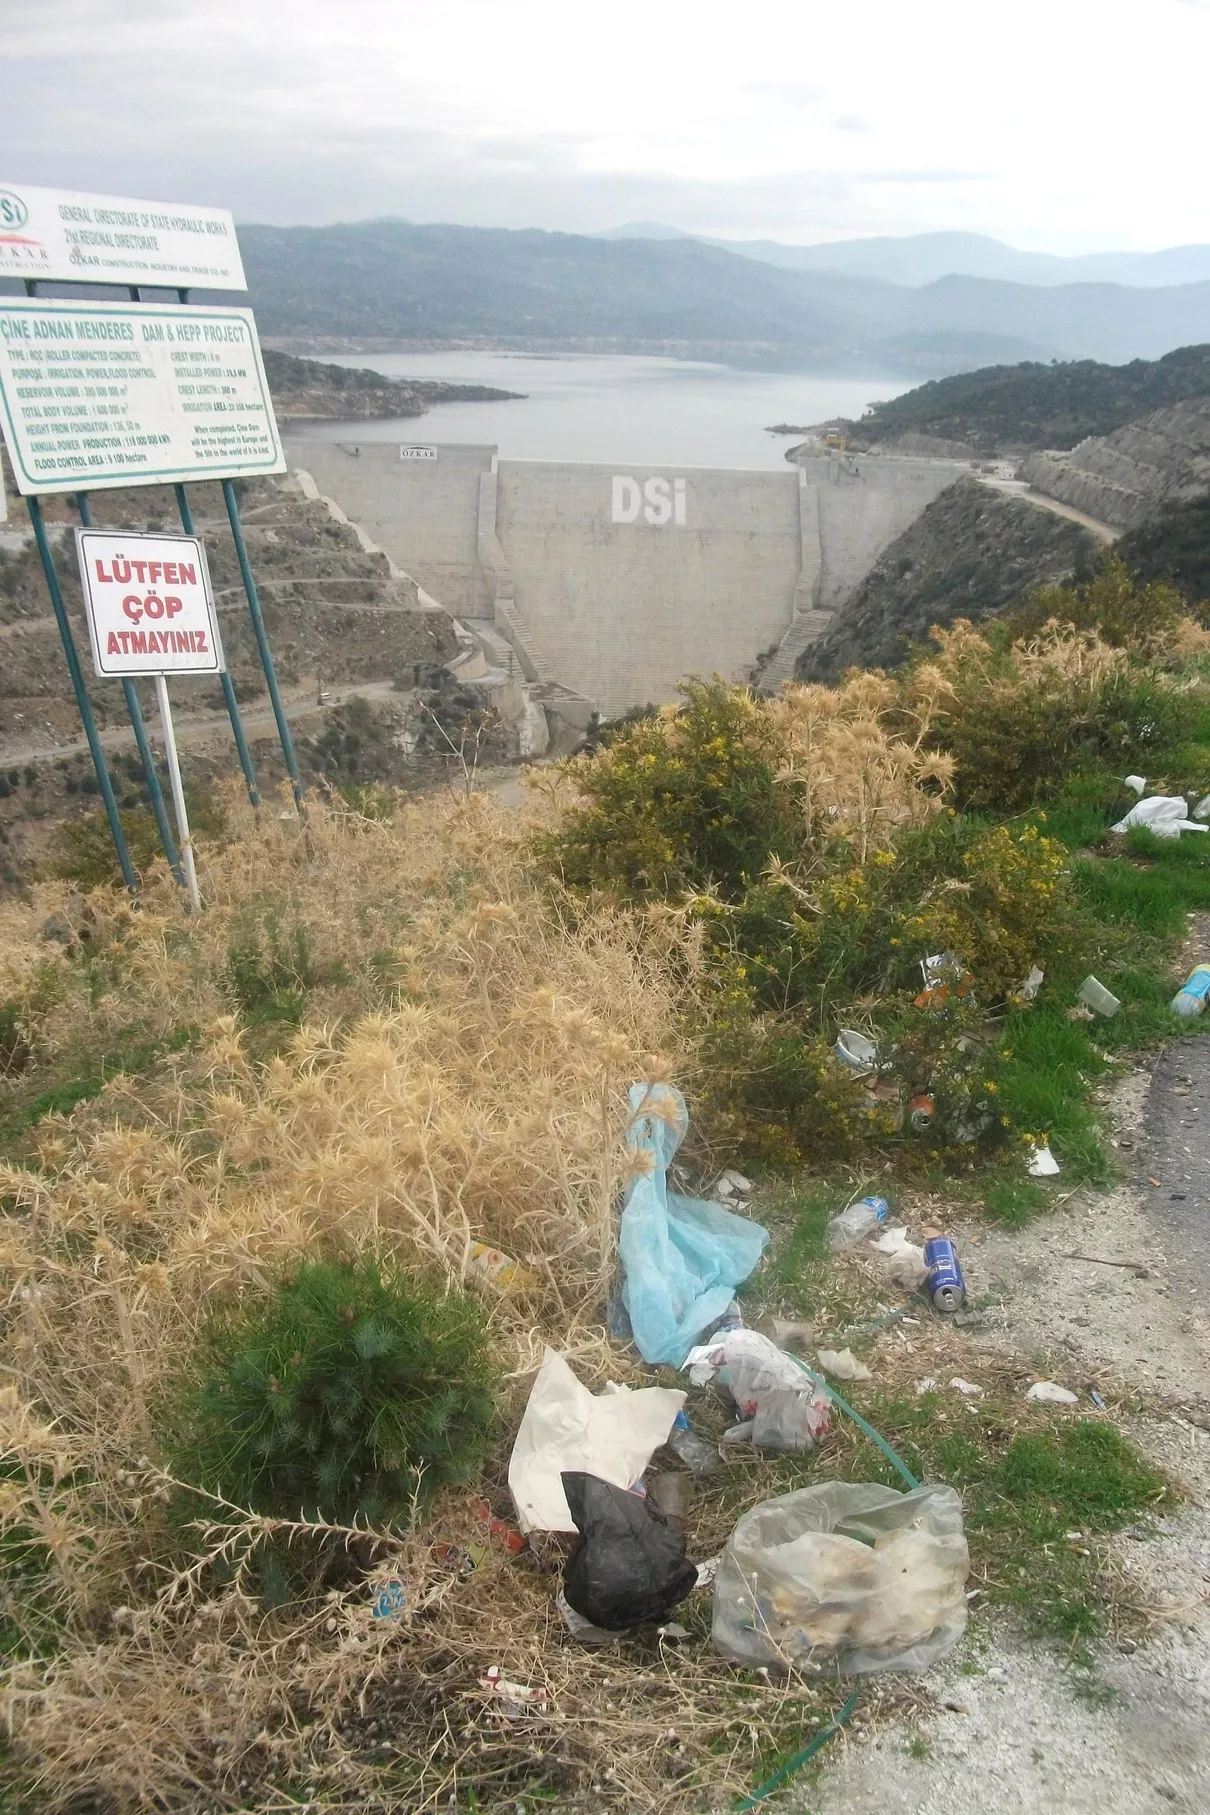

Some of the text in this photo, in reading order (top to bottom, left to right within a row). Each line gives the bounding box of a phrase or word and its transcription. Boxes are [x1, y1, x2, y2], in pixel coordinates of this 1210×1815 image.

[58, 204, 228, 236] GENERAL DIRECTORATE OF STATE HYDRAULIC WORKS
[80, 229, 115, 248] REGIONAL
[114, 233, 160, 251] DIRECTORATE
[33, 319, 74, 340] ADNAN
[75, 320, 134, 341] MENDERES
[141, 324, 165, 342] DAM
[166, 324, 175, 342] &
[175, 324, 201, 342] HEPP
[203, 324, 245, 343] PROJECT
[7, 350, 25, 361] TYPE
[71, 350, 108, 361] COMPACTED
[12, 368, 43, 379] PURPOSE
[128, 368, 156, 378] CONTROL
[174, 368, 203, 378] INSTALLED
[203, 368, 222, 378] POWER
[16, 387, 54, 398] RESERVOIR
[53, 386, 80, 397] VOLUME
[20, 406, 43, 418] TOTAL
[43, 405, 60, 417] BODY
[60, 405, 88, 417] VOLUME
[25, 424, 50, 436] HEIGHT
[51, 423, 70, 434] FROM
[70, 421, 109, 434] FOUNDATION
[30, 441, 57, 453] ANNUAL
[57, 440, 80, 452] POWER
[83, 437, 122, 449] PRODUCTION
[34, 457, 57, 470] FLOOD
[57, 455, 87, 469] CONTROL
[88, 454, 104, 467] AREA
[124, 451, 147, 464] hectare
[95, 553, 197, 585] LÜTFEN
[122, 589, 183, 626] ÇÖP
[107, 630, 209, 655] ATMAYINIZ
